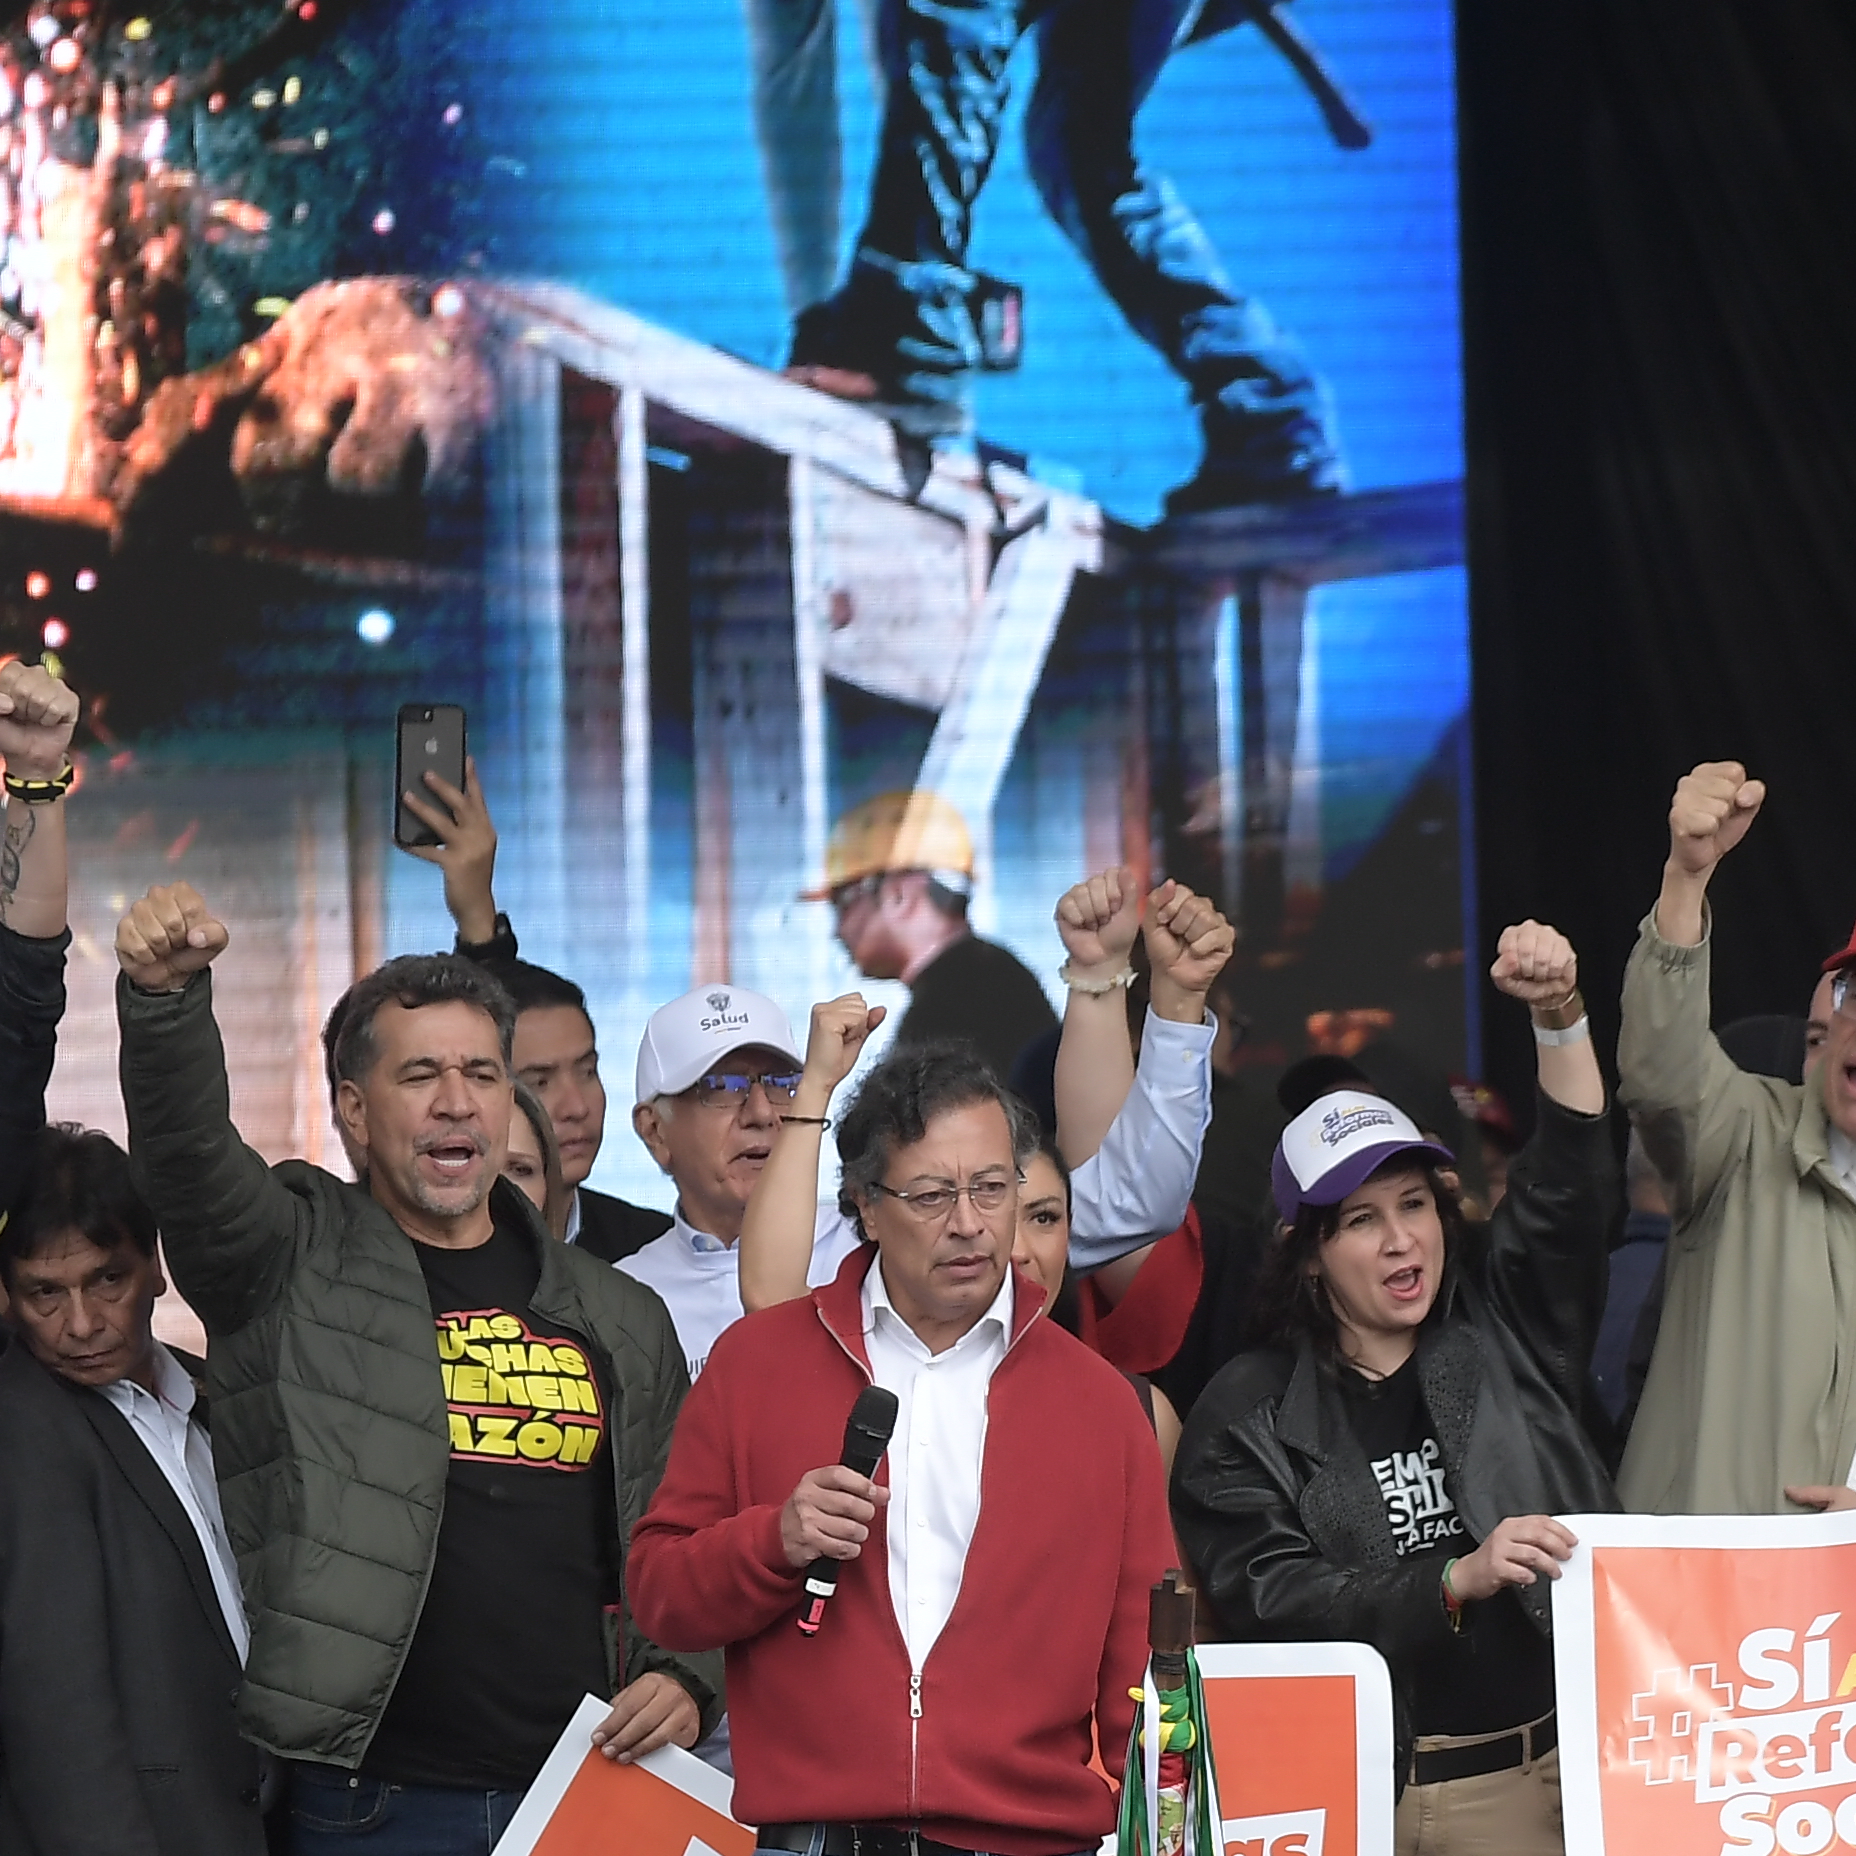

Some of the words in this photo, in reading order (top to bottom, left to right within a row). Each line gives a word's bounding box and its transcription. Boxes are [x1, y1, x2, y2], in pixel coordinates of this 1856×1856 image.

[700, 1012, 749, 1031] Salud
[437, 1331, 588, 1377] UCHAS
[441, 1363, 599, 1415] IENEN
[447, 1409, 600, 1463] AZÓN
